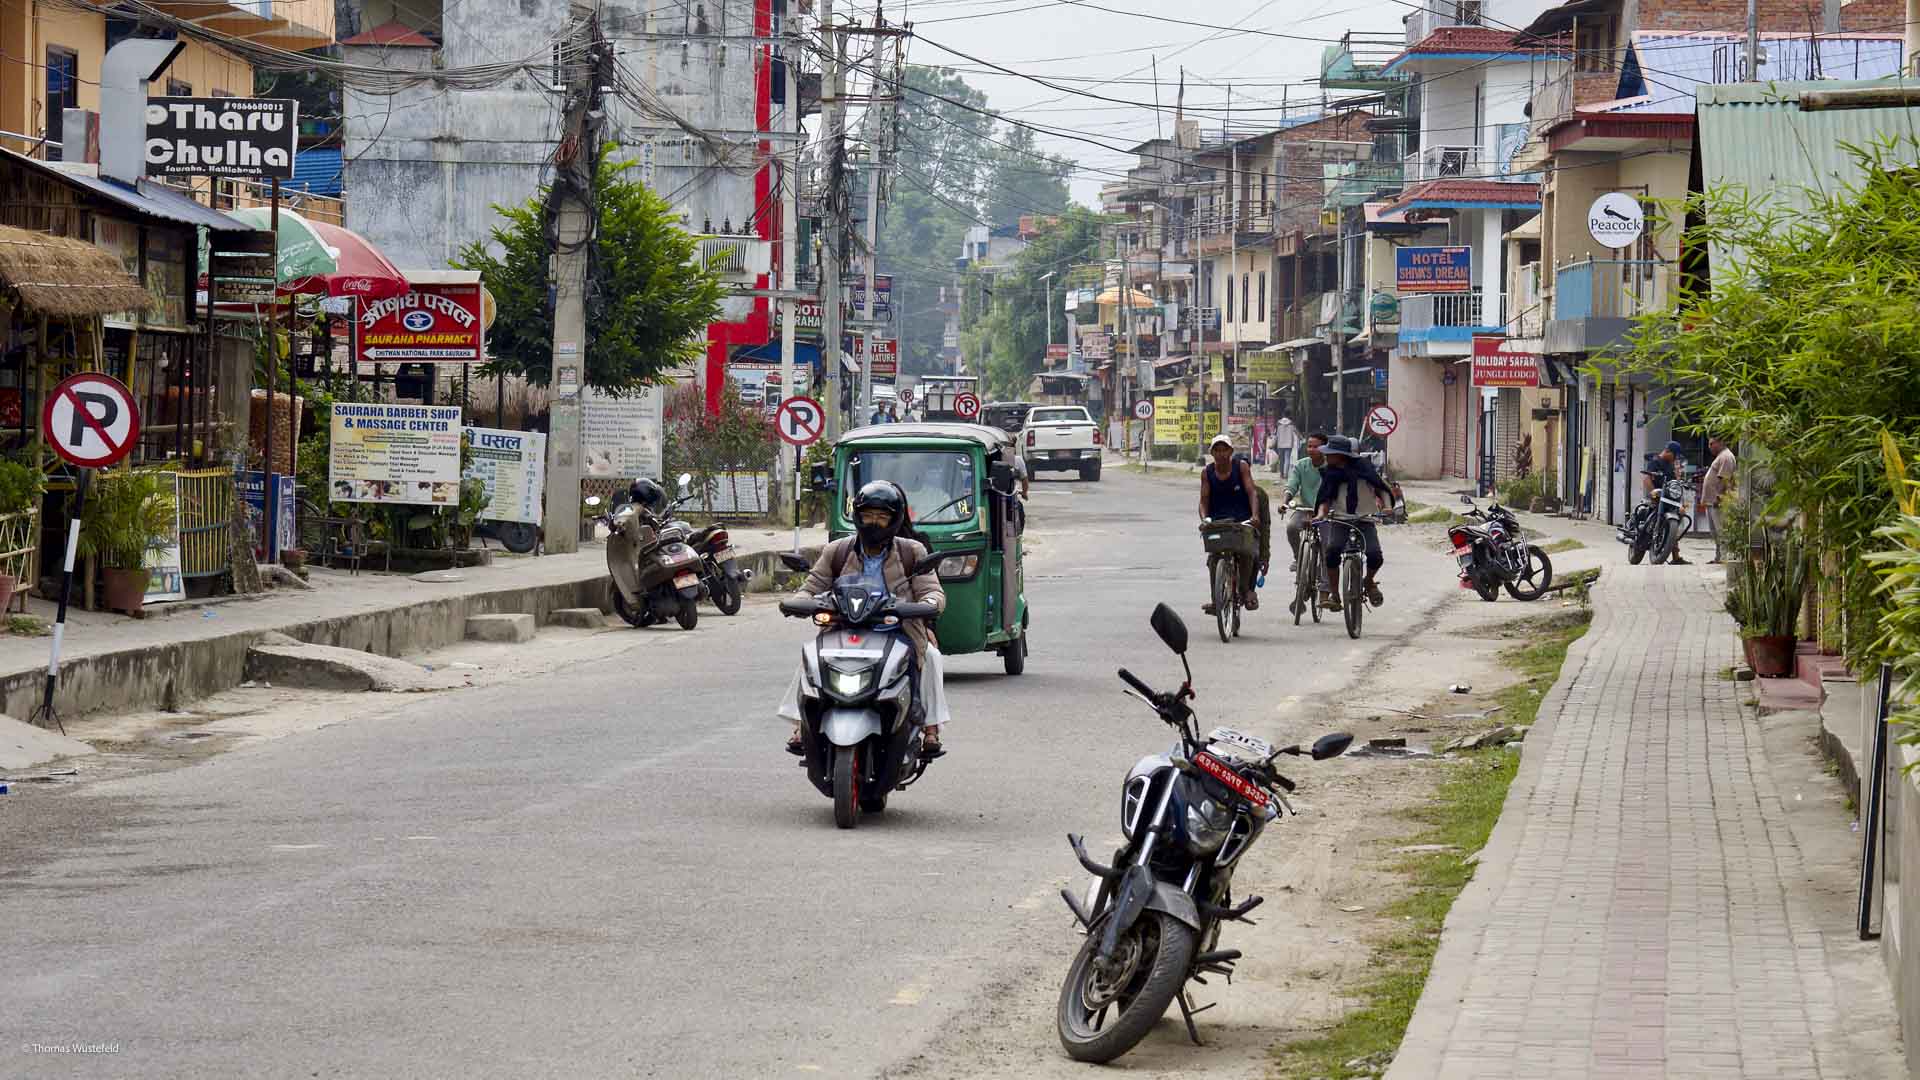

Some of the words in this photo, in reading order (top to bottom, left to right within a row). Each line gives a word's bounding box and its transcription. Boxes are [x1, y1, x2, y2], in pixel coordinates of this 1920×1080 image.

[169, 103, 284, 132] Tharu
[145, 138, 288, 166] Chulha
[1591, 218, 1641, 231] Peacock
[1411, 252, 1455, 265] HOTEL
[1434, 265, 1468, 280] DREAM
[365, 335, 415, 345] SAURAHA
[416, 335, 473, 345] PHARMACY
[375, 349, 401, 357] CHITWAN
[402, 349, 428, 357] NATIONAL
[429, 349, 444, 357] PARK
[1475, 355, 1508, 367] HOLIDAY
[1474, 369, 1508, 378] JUNGLE
[1509, 369, 1537, 378] LODGE
[334, 405, 384, 418] SAURAHA
[386, 407, 429, 420] BARBER
[430, 409, 459, 420] SHOP
[1138, 404, 1151, 415] 40
[344, 417, 354, 428] &
[356, 418, 407, 431] MASSAGE
[412, 420, 449, 432] CENTER
[481, 433, 521, 450] पसल
